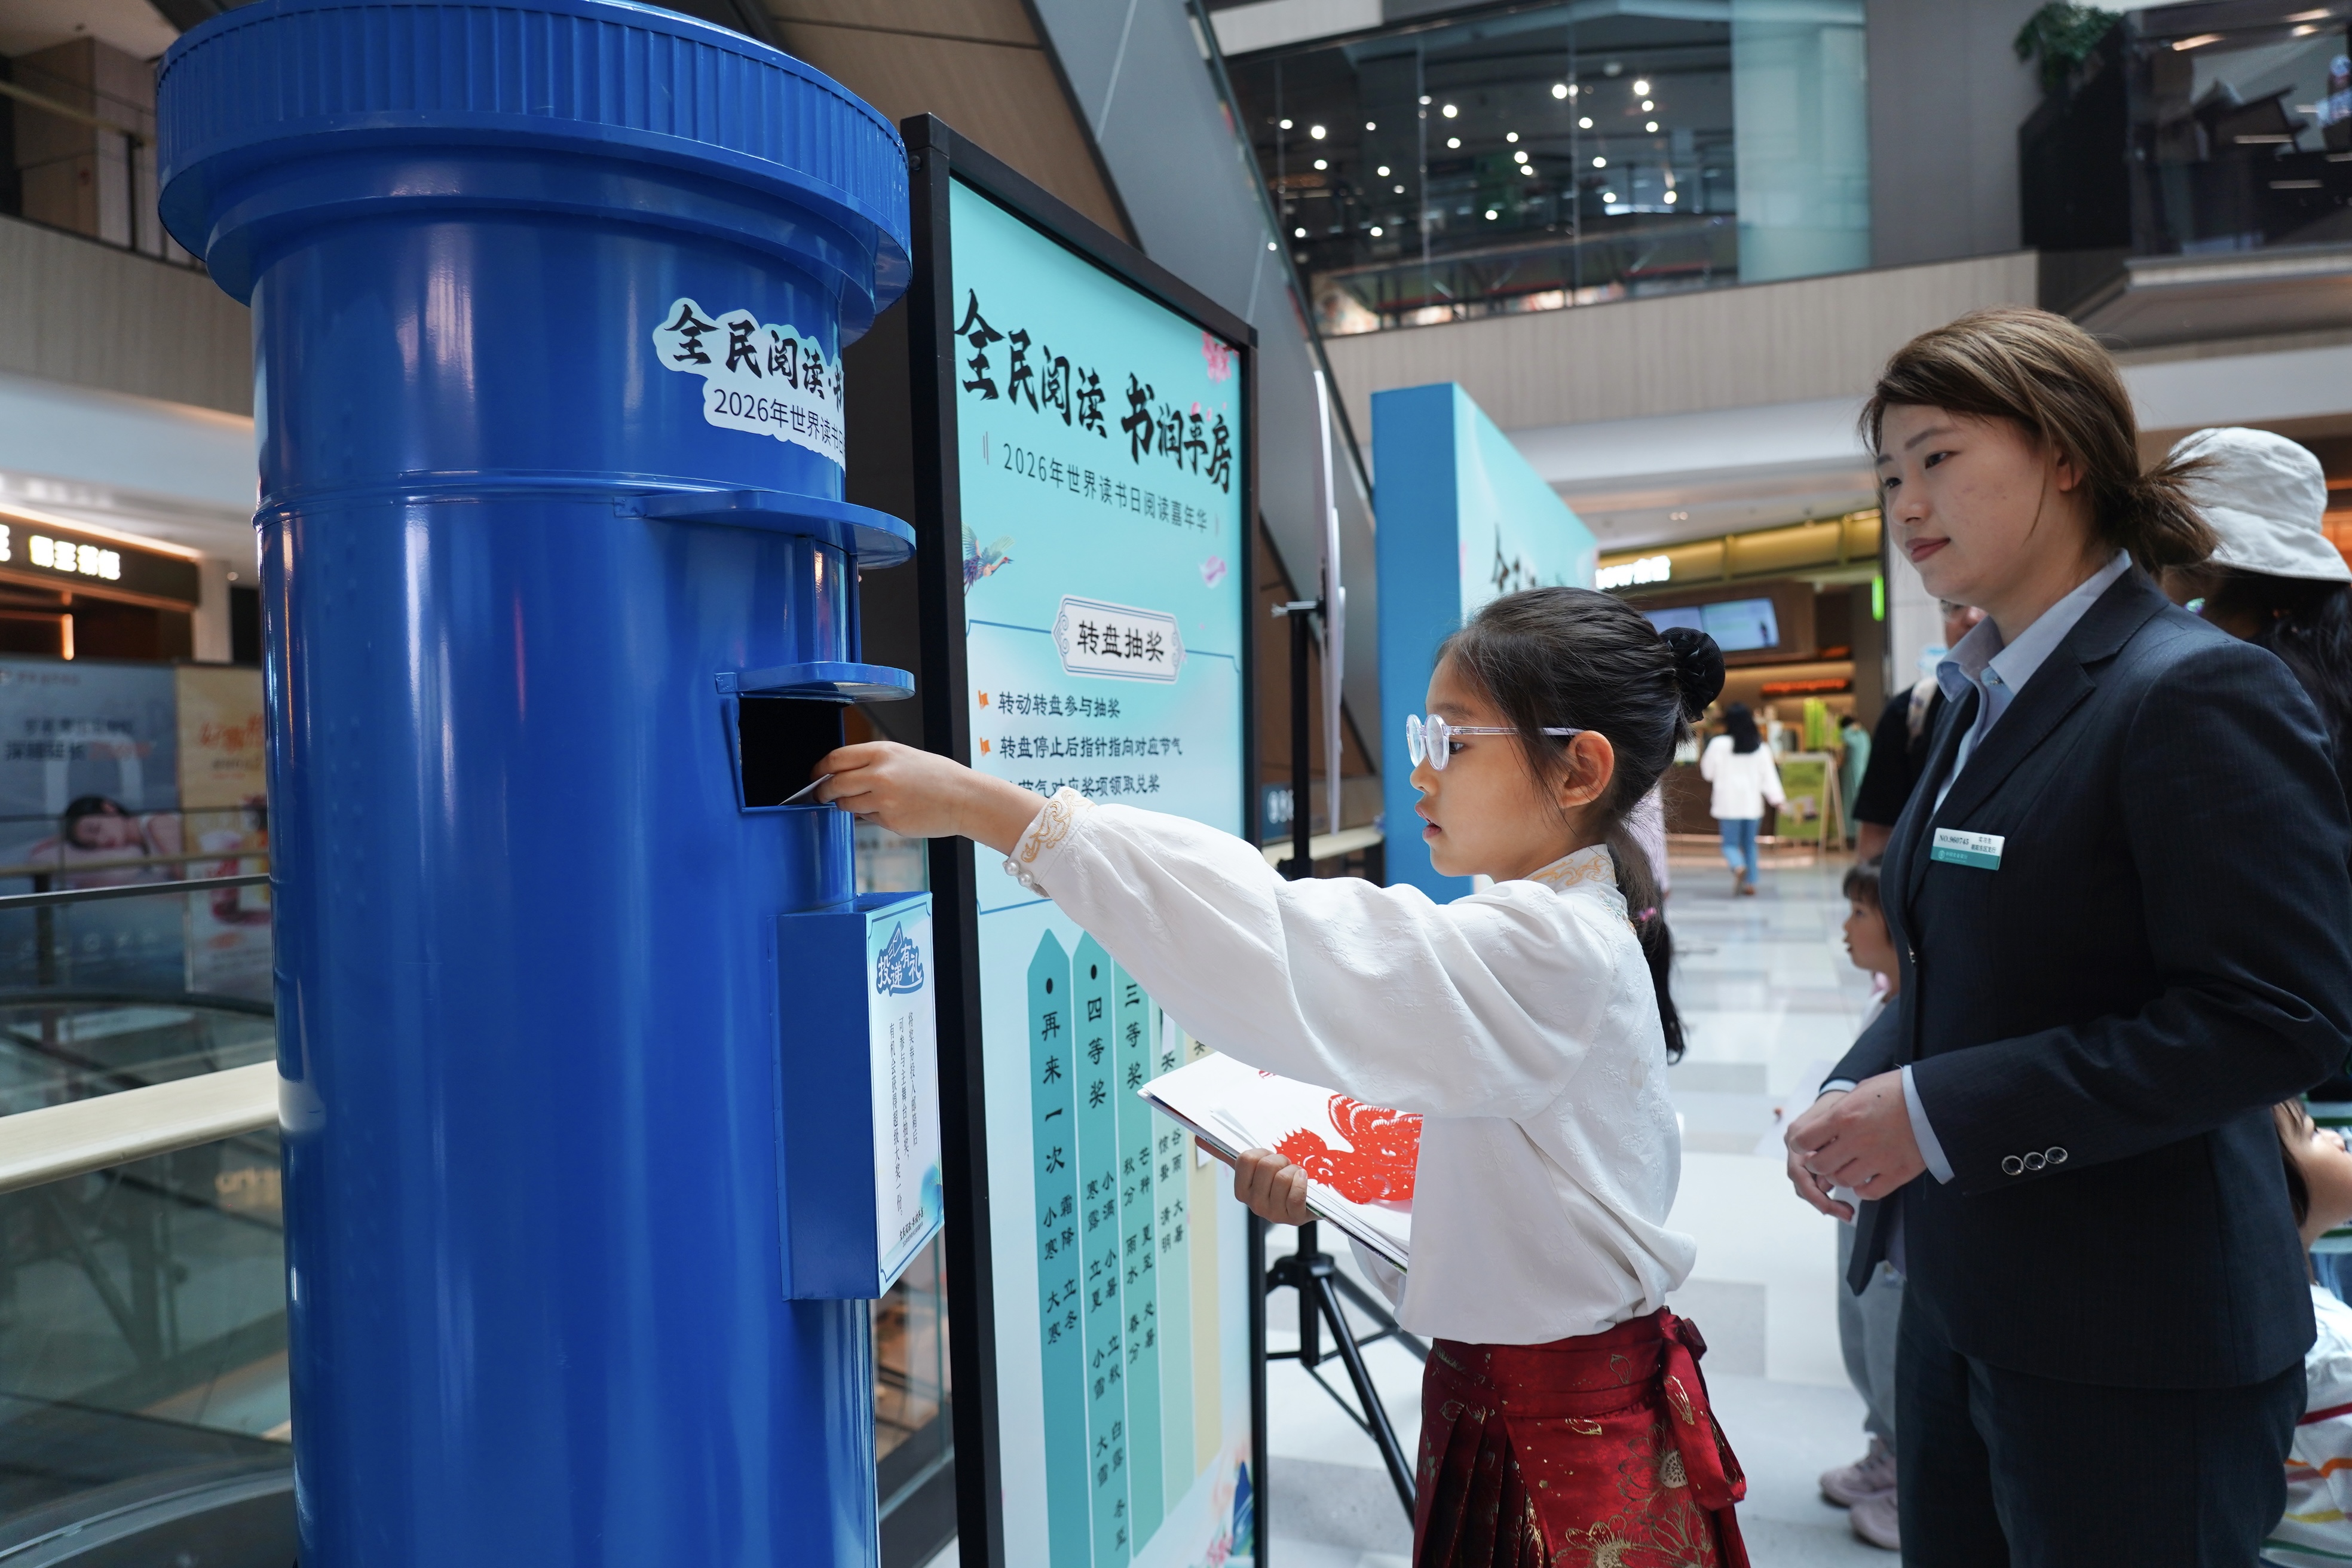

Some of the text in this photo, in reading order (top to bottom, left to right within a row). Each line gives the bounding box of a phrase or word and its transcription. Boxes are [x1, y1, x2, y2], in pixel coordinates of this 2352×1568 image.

[954, 288, 1108, 439] 全民阅读
[713, 388, 845, 458] 2026年世界读书日
[1003, 443, 1208, 533] 2026年世界读书日阅读嘉年华
[1077, 620, 1165, 662] 转盘抽奖
[998, 691, 1121, 718] 转动转盘参与抽奖
[999, 736, 1183, 759] 转盘停止后指针指向对应节气
[1010, 773, 1160, 798] 节气对应奖项领取兑奖
[878, 944, 923, 990] 投递有礼
[1087, 997, 1106, 1108] 四等奖
[1125, 984, 1142, 1089] 三等奖
[1042, 1011, 1065, 1174] 再来一次
